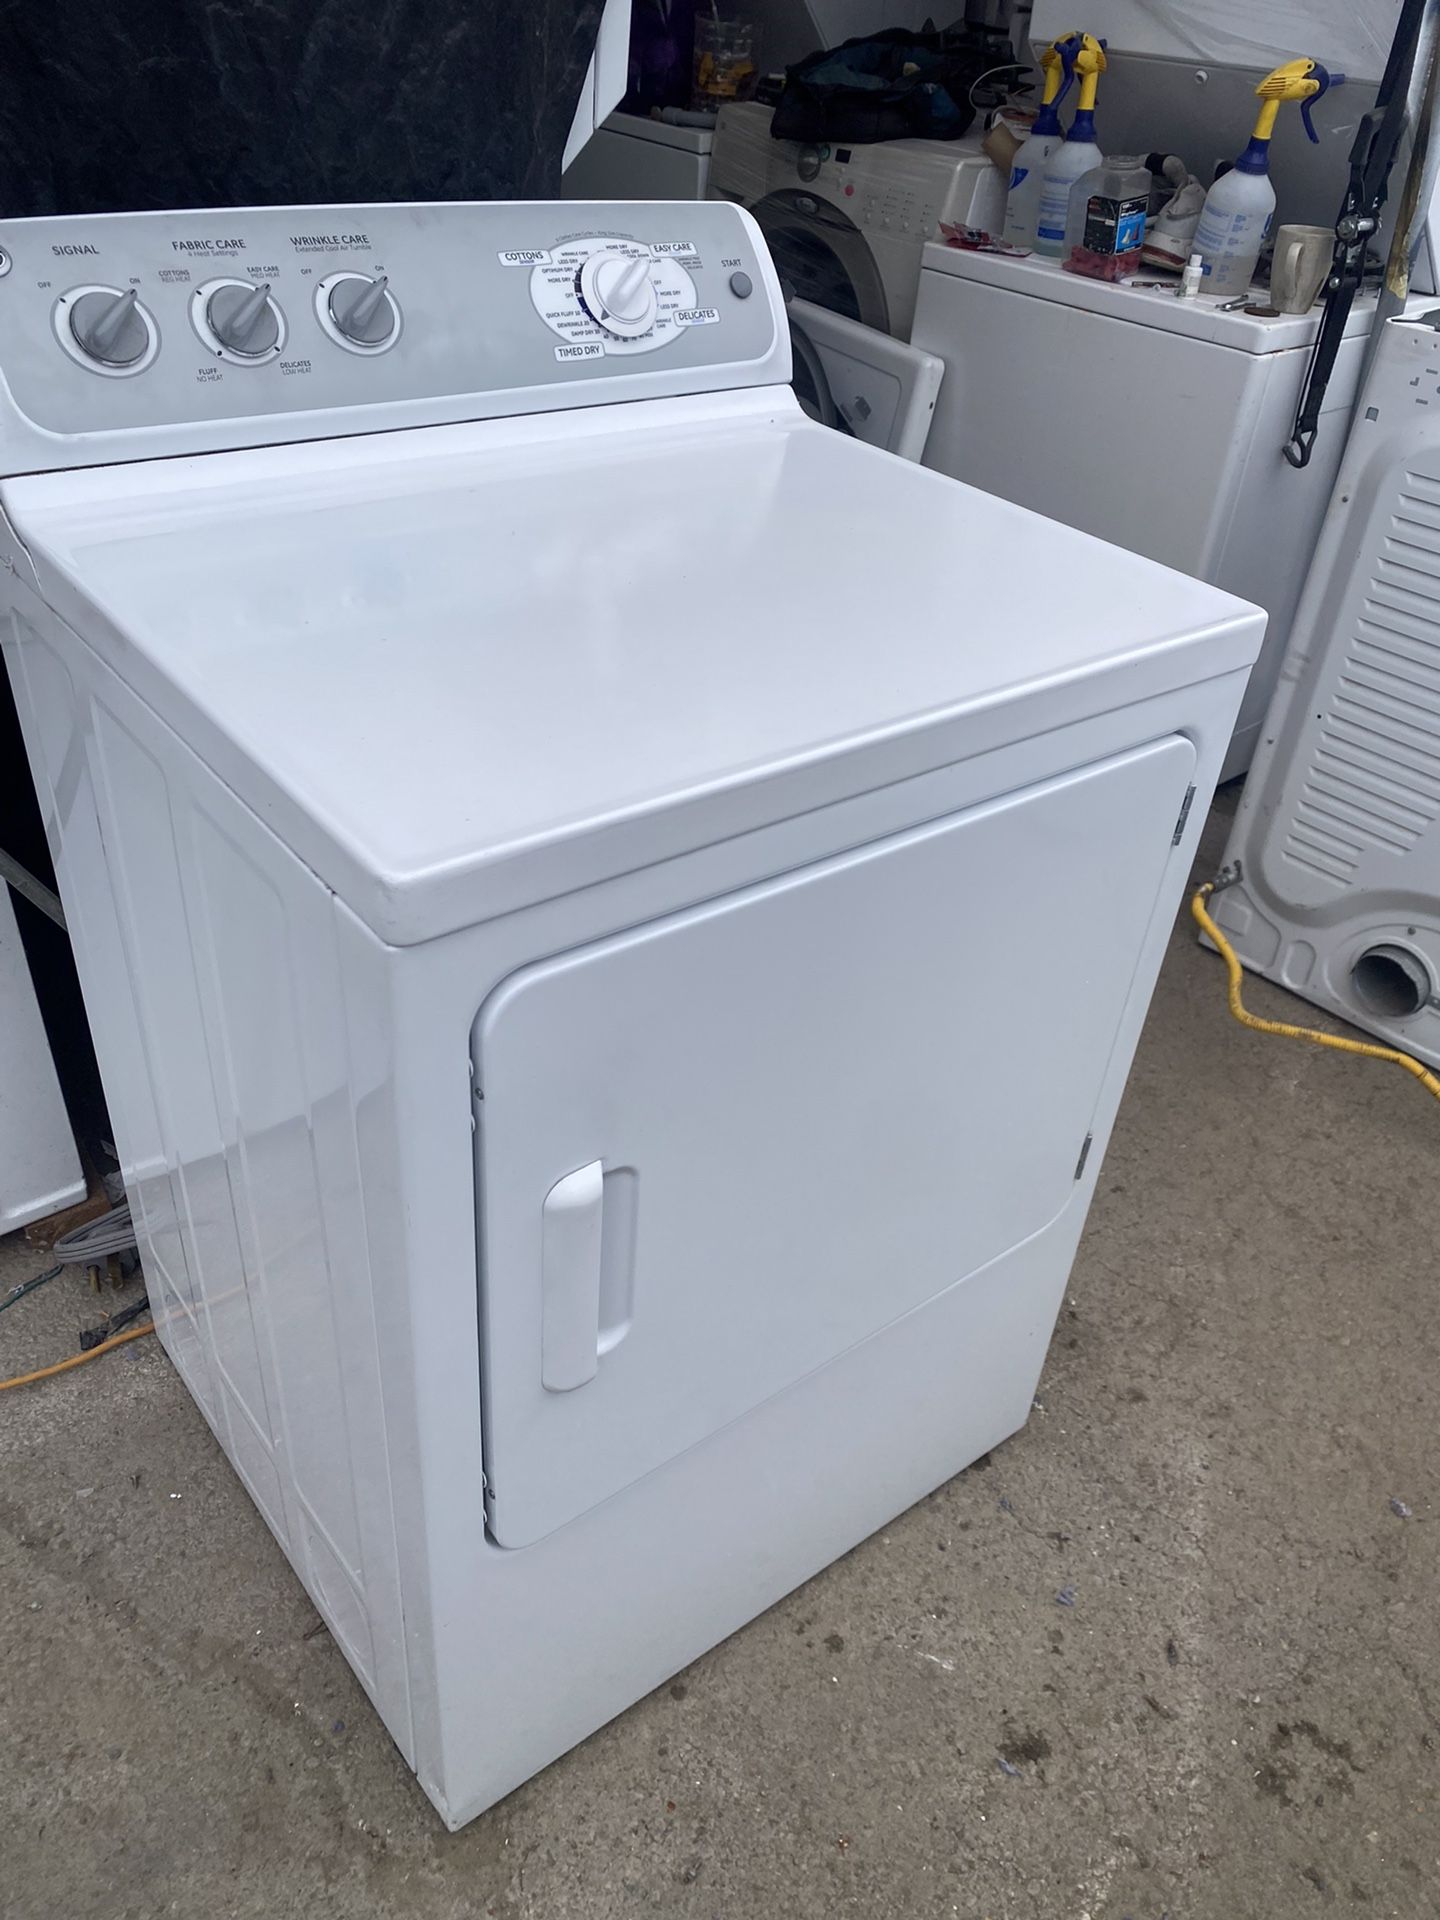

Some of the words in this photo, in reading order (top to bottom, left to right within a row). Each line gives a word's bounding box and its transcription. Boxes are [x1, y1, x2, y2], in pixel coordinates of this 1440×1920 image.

[290, 236, 341, 246] WRINKLE
[342, 234, 370, 244] CARE
[171, 240, 214, 251] FABRIC
[215, 239, 247, 249] CARE
[653, 244, 671, 253] EASY
[672, 242, 692, 252] CARE
[52, 244, 100, 256] SIGNAL
[505, 251, 543, 261] COTTONS
[721, 259, 742, 267] START
[158, 269, 189, 277] COTTONS
[37, 281, 51, 289] OFF
[129, 277, 141, 285] ON
[678, 310, 715, 321] DELICATES
[558, 345, 583, 357] TIMED
[584, 345, 600, 356] DRY
[280, 361, 311, 369] DELICATES
[198, 368, 218, 376] FLUFF
[196, 375, 207, 383] NO
[208, 374, 223, 382] HEAT
